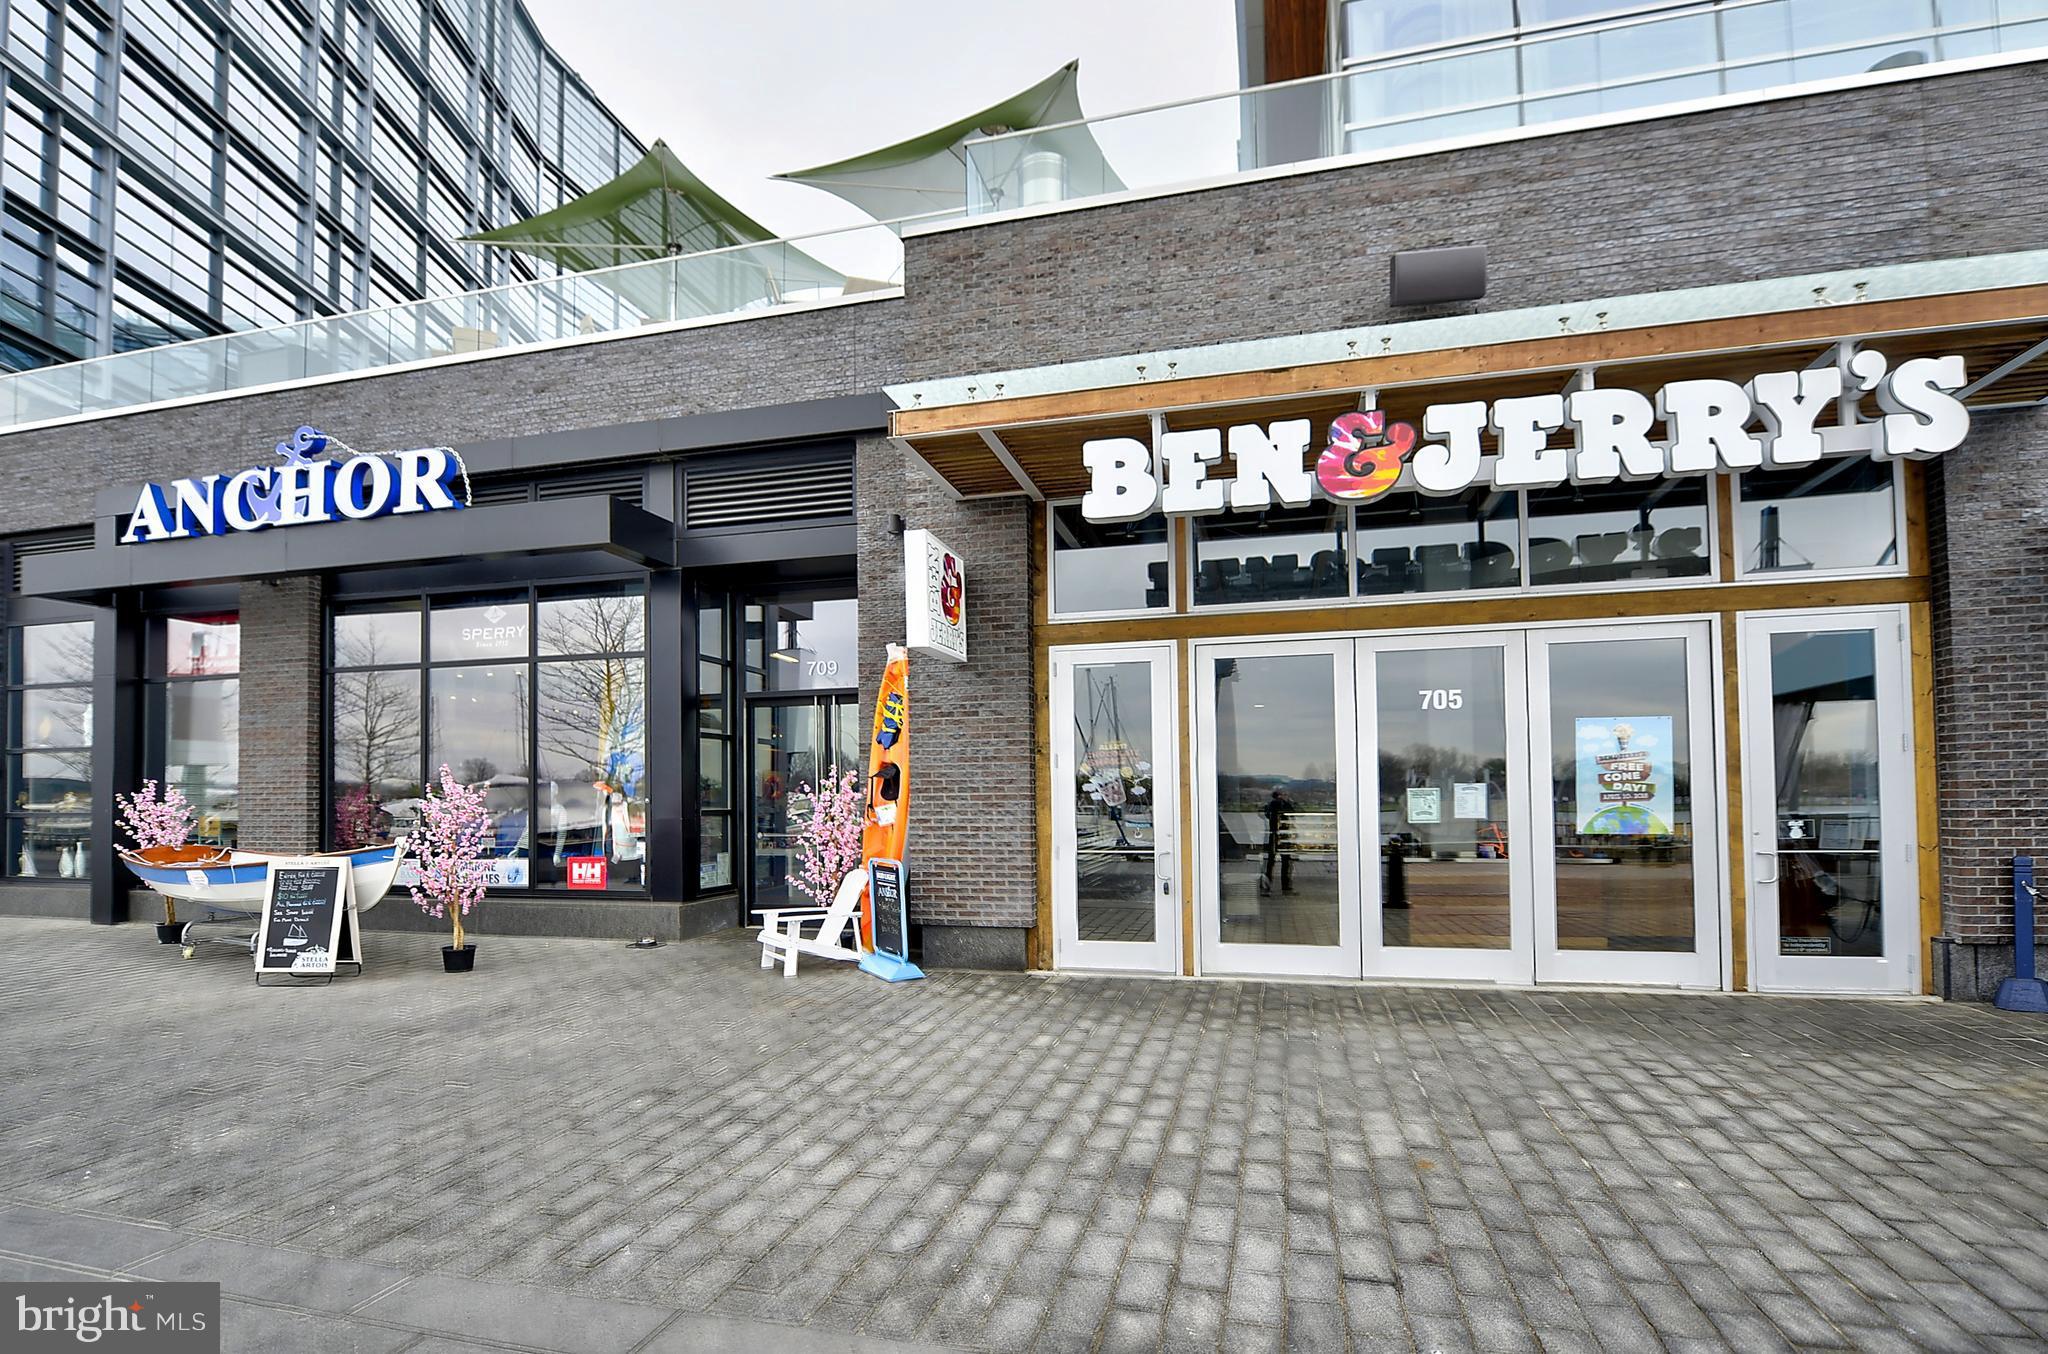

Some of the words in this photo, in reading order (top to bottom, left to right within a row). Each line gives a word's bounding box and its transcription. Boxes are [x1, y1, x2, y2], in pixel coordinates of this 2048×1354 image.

[1082, 419, 1311, 525] BEN
[1316, 410, 1415, 506] &
[1412, 348, 1971, 498] JERRY'S
[120, 447, 464, 543] ANCHOR
[462, 625, 526, 641] SPERRY
[807, 660, 839, 676] 709
[1418, 689, 1463, 710] 705
[1611, 762, 1644, 771] FREE
[1603, 771, 1641, 782] CONE
[1612, 783, 1647, 792] DAY!
[460, 861, 496, 872] MRNE
[456, 874, 500, 884] SLIES
